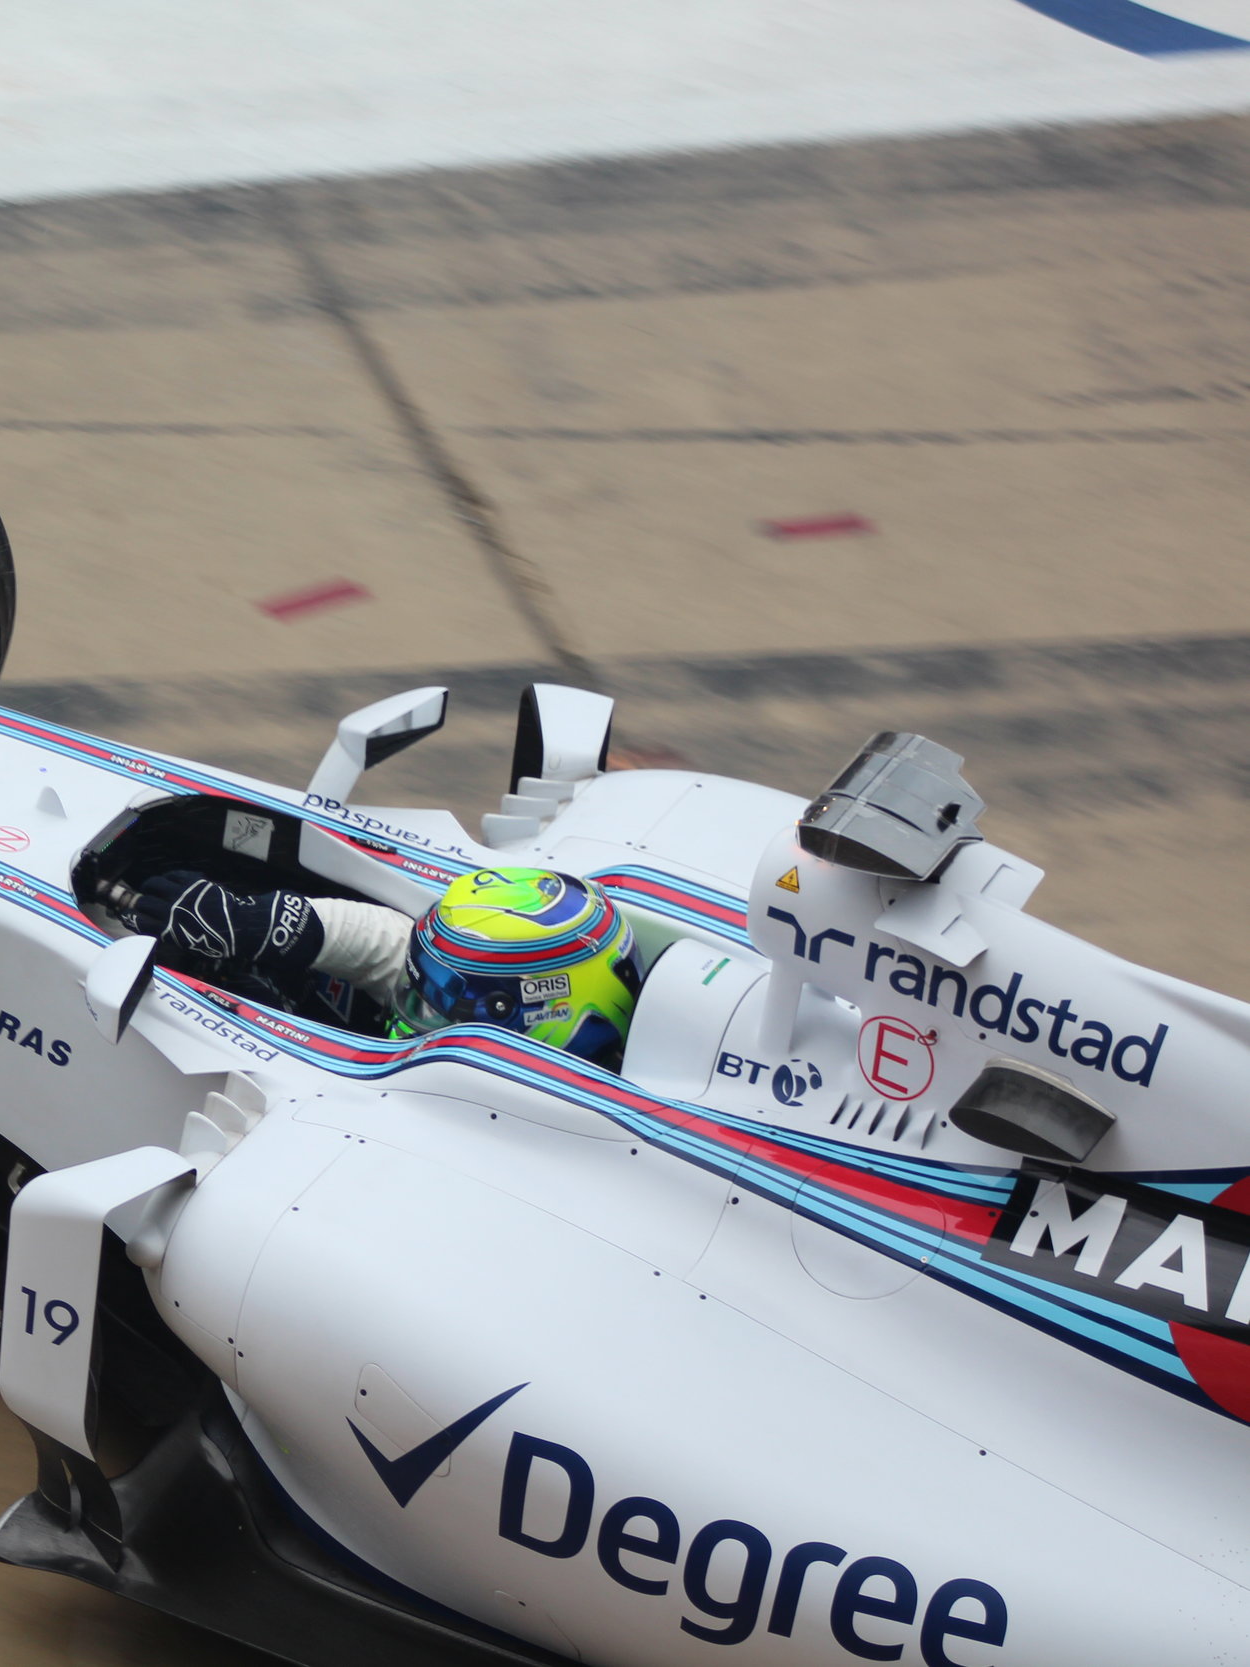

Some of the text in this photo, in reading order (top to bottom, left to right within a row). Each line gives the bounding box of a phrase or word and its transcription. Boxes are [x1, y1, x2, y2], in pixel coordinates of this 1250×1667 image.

[110, 754, 166, 779] MARTINI
[303, 793, 431, 848] randstad
[272, 894, 302, 947] ORIS
[523, 976, 567, 995] ORIS
[159, 992, 279, 1062] randstad
[255, 1015, 311, 1044] MARTINI
[864, 941, 1169, 1089] randstad
[716, 1051, 770, 1085] BT
[872, 1022, 915, 1095] E
[21, 1285, 80, 1347] 19
[498, 1430, 1008, 1667] Degree
